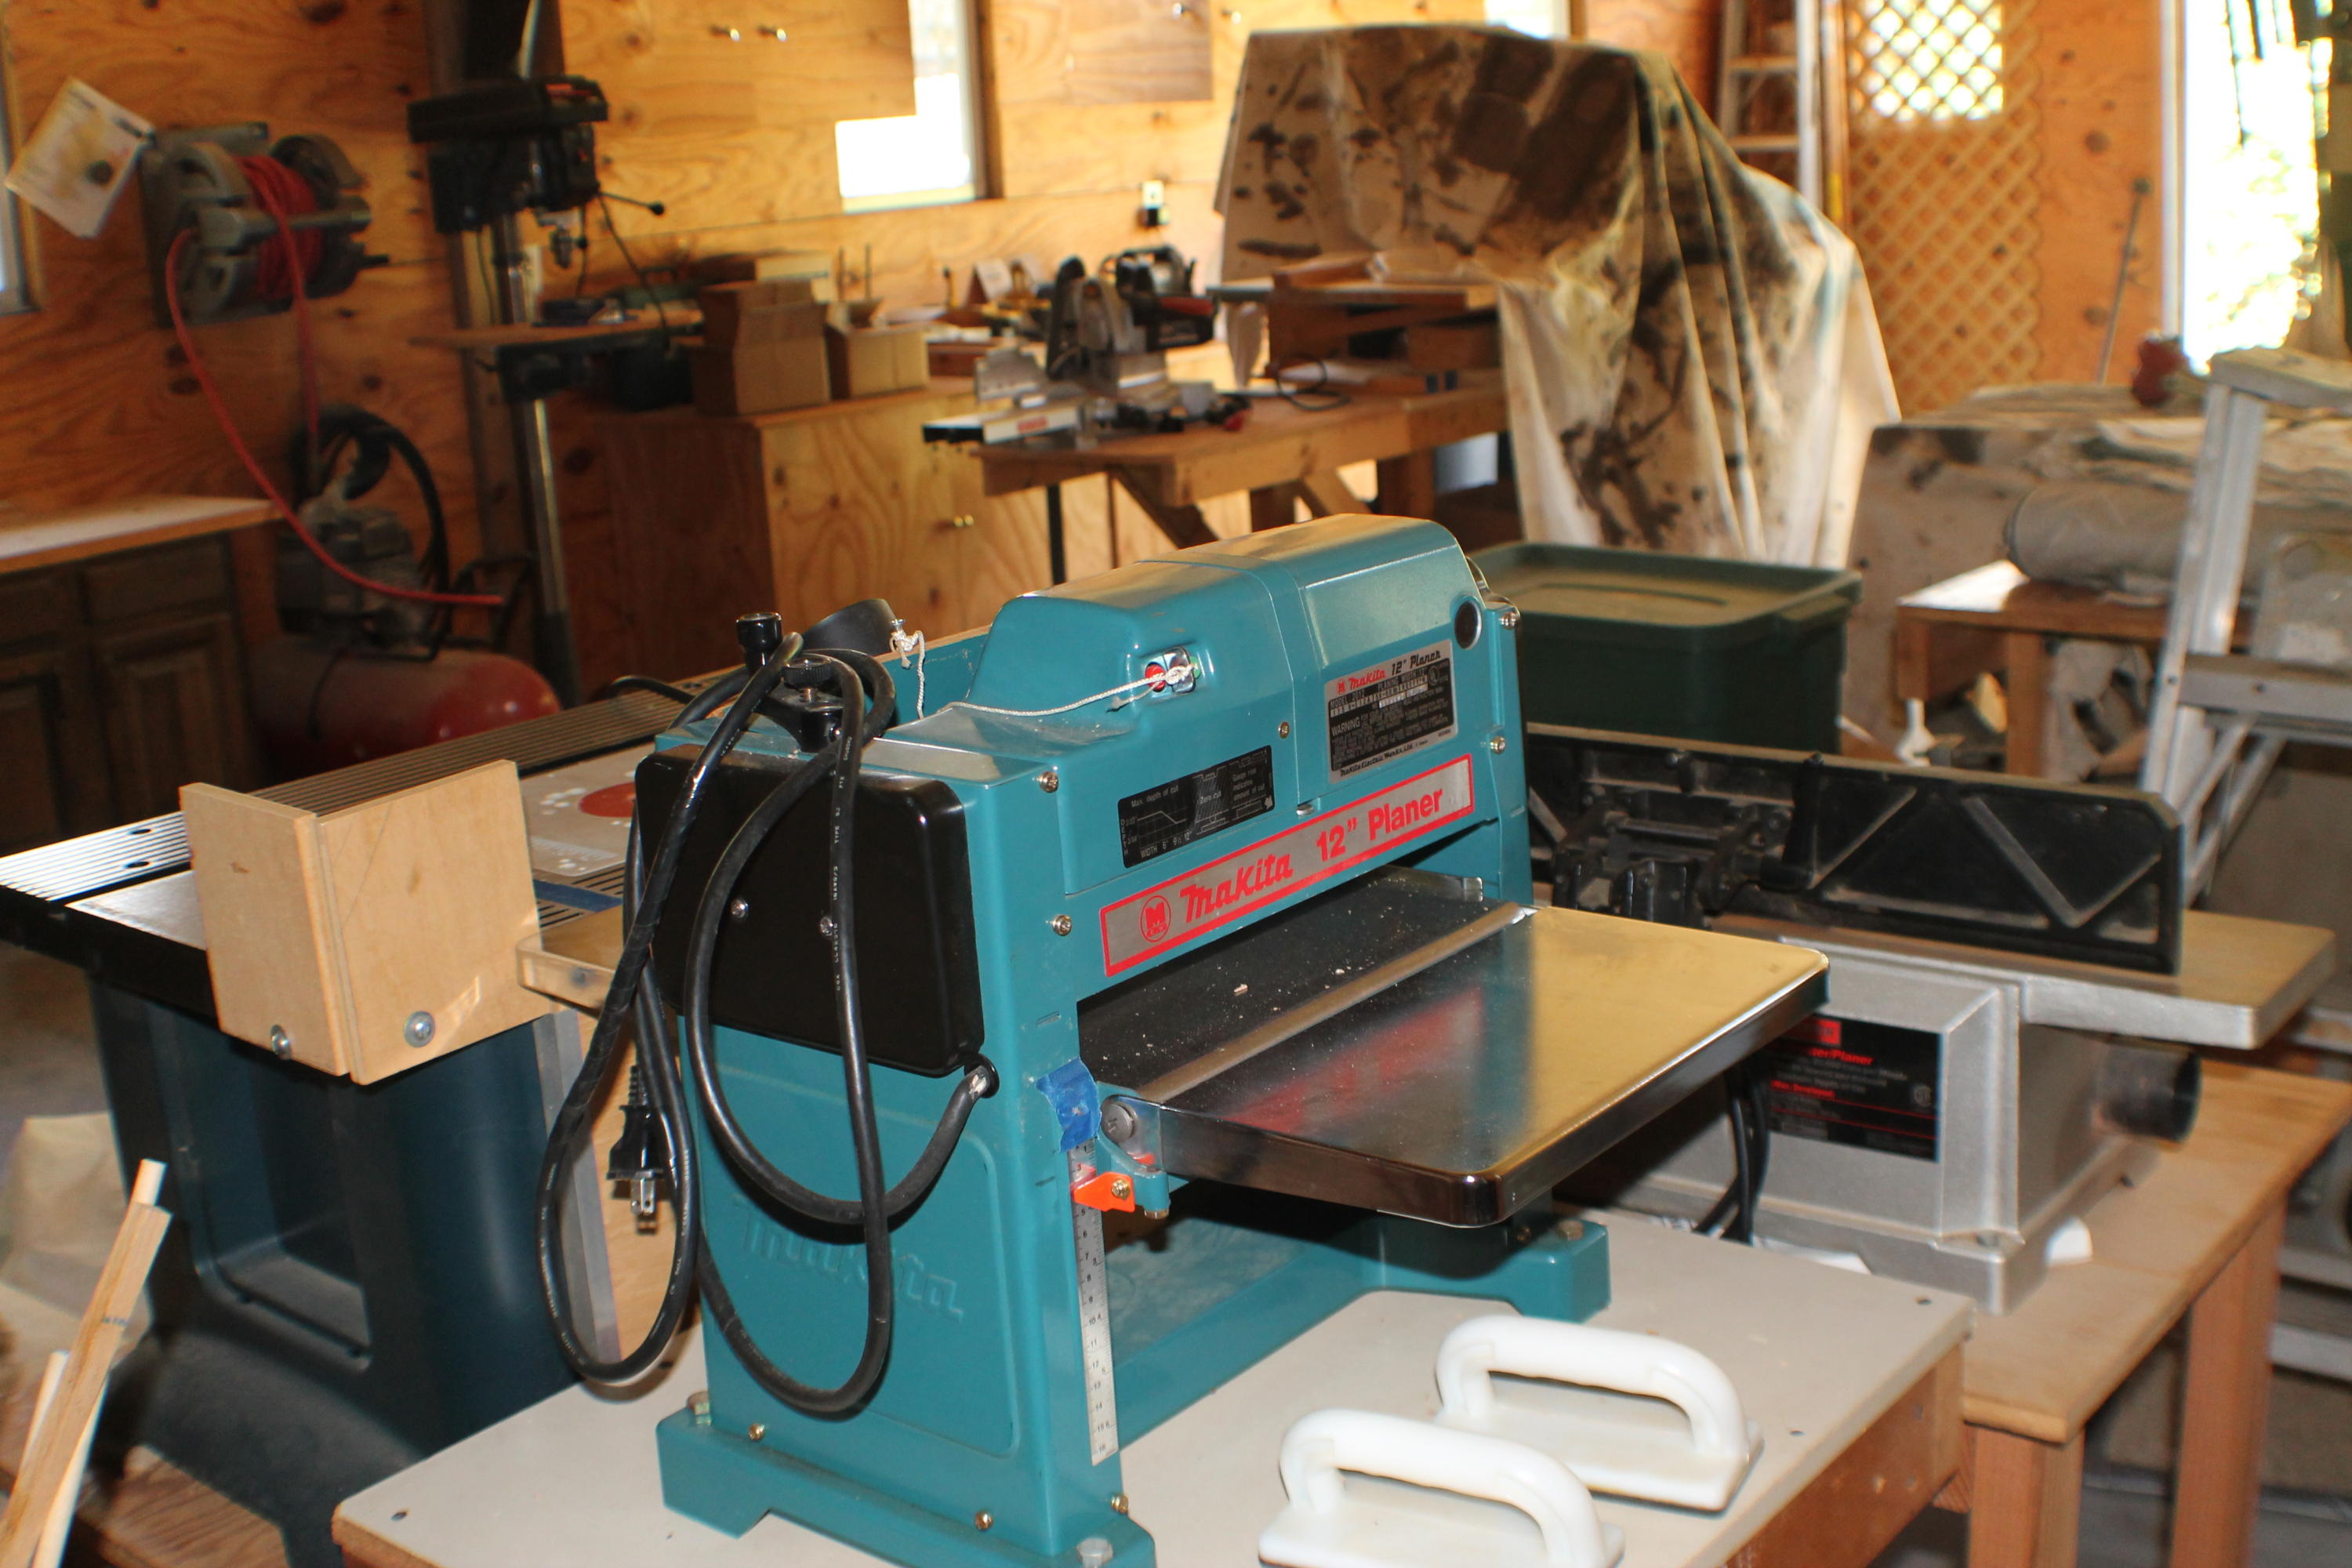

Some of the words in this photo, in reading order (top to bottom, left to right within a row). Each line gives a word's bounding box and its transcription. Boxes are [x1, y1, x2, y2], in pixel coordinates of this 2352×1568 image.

[1331, 717, 1360, 736] WARNING
[1140, 846, 1158, 858] WIDTH
[1180, 854, 1294, 923] Makita
[1368, 788, 1443, 840] Planer
